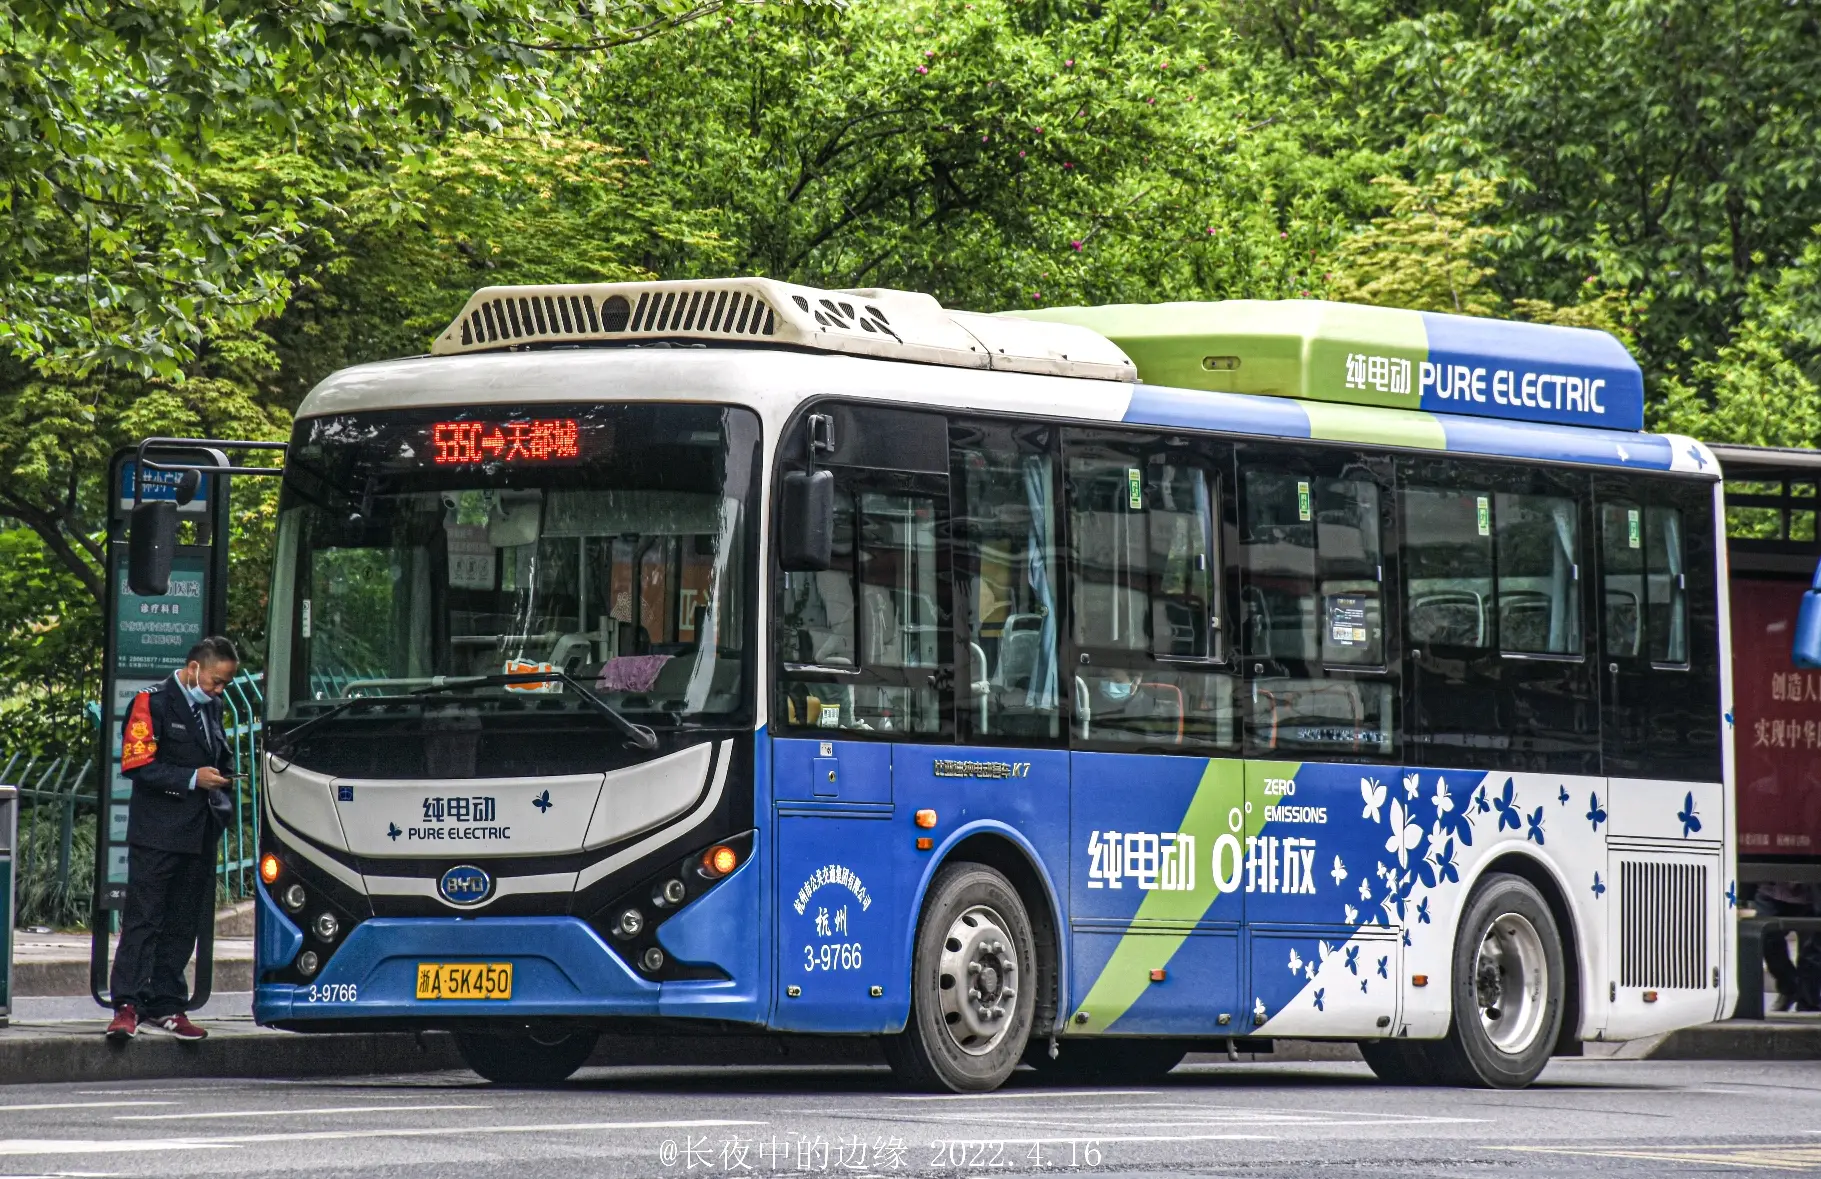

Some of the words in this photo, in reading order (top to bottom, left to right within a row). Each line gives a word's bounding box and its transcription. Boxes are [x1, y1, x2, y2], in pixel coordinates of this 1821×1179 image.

[1345, 353, 1411, 395] 纯电动
[1418, 361, 1487, 403] PURE
[1492, 370, 1606, 414] ELECTRIC
[1771, 672, 1821, 702] 创造人
[1752, 717, 1821, 750] 实现中华
[1012, 762, 1031, 778] K7
[1263, 778, 1296, 796] ZERO
[422, 796, 496, 823] 纯电动
[1264, 805, 1327, 824] EMISSIONS
[408, 827, 445, 840] PURE
[447, 826, 511, 840] ELECTRIC
[1087, 830, 1196, 891] 纯电动
[446, 877, 485, 894] BYD
[815, 904, 848, 938] 杭州
[803, 942, 862, 972] 3-9766
[308, 983, 358, 1003] 3-9766
